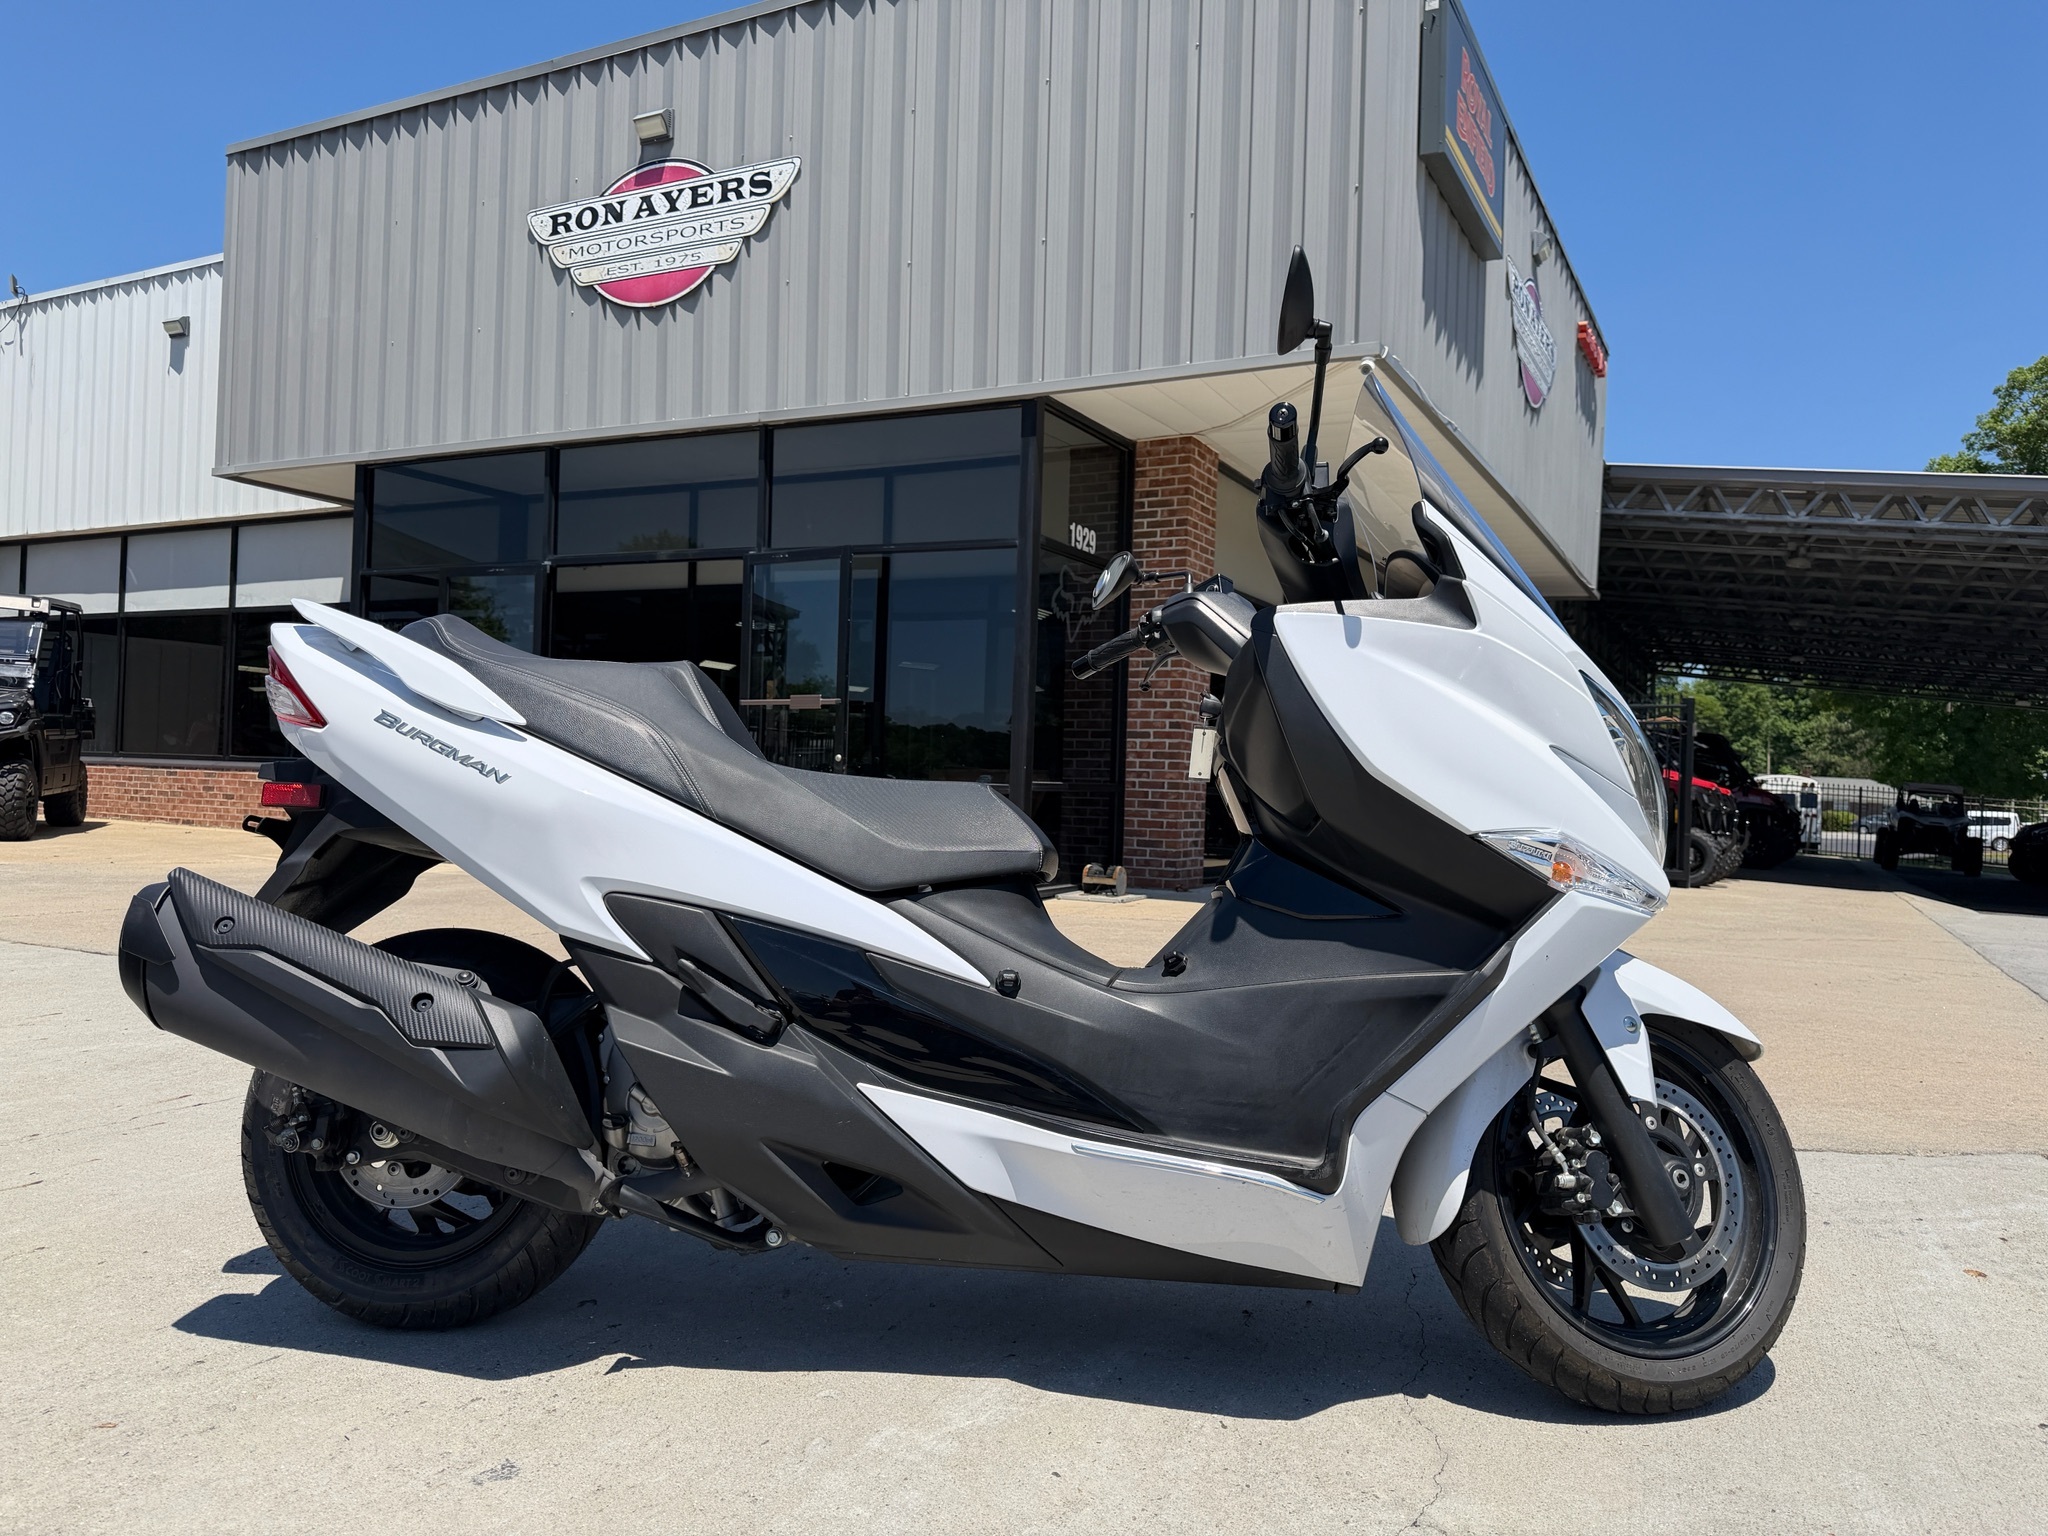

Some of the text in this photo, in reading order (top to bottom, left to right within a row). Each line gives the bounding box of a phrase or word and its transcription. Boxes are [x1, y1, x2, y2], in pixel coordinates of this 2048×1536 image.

[1461, 46, 1492, 150] ROYAL
[548, 170, 773, 237] RON AYERS
[568, 216, 745, 260] MOTORSPORTS
[606, 251, 702, 276] EST. 1975
[1069, 521, 1097, 555] 1929
[373, 708, 512, 785] BURGMAN
[1506, 840, 1552, 861] SUZUKI
